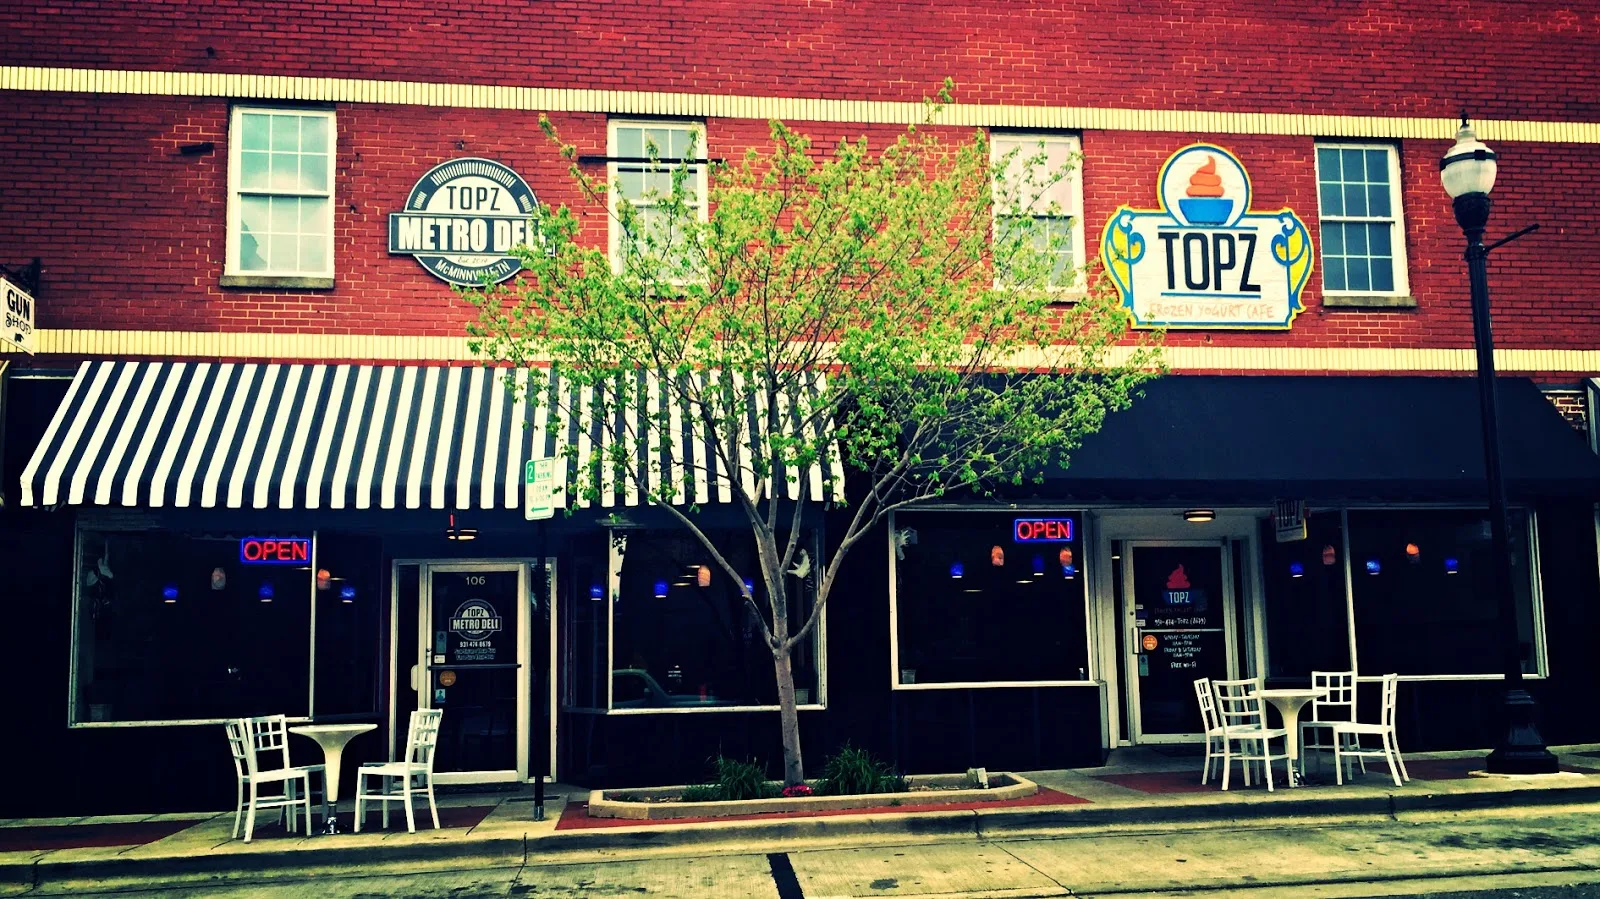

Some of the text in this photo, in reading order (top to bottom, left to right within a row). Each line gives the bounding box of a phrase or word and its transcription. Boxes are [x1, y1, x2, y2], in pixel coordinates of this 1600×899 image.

[446, 185, 501, 211] TOPZ
[398, 216, 488, 252] METRO
[495, 260, 511, 275] TN
[1158, 232, 1261, 292] TOPZ
[7, 289, 30, 321] GUN
[1149, 303, 1275, 319] FROZEN YOGURT CAFE
[6, 312, 31, 334] SHOP
[527, 464, 534, 480] 2
[1017, 521, 1071, 539] OPEN
[243, 541, 308, 560] OPEN
[465, 576, 486, 585] 106
[1169, 591, 1191, 604] TOPZ
[467, 608, 484, 617] TOPZ
[452, 618, 499, 630] METRO DELI
